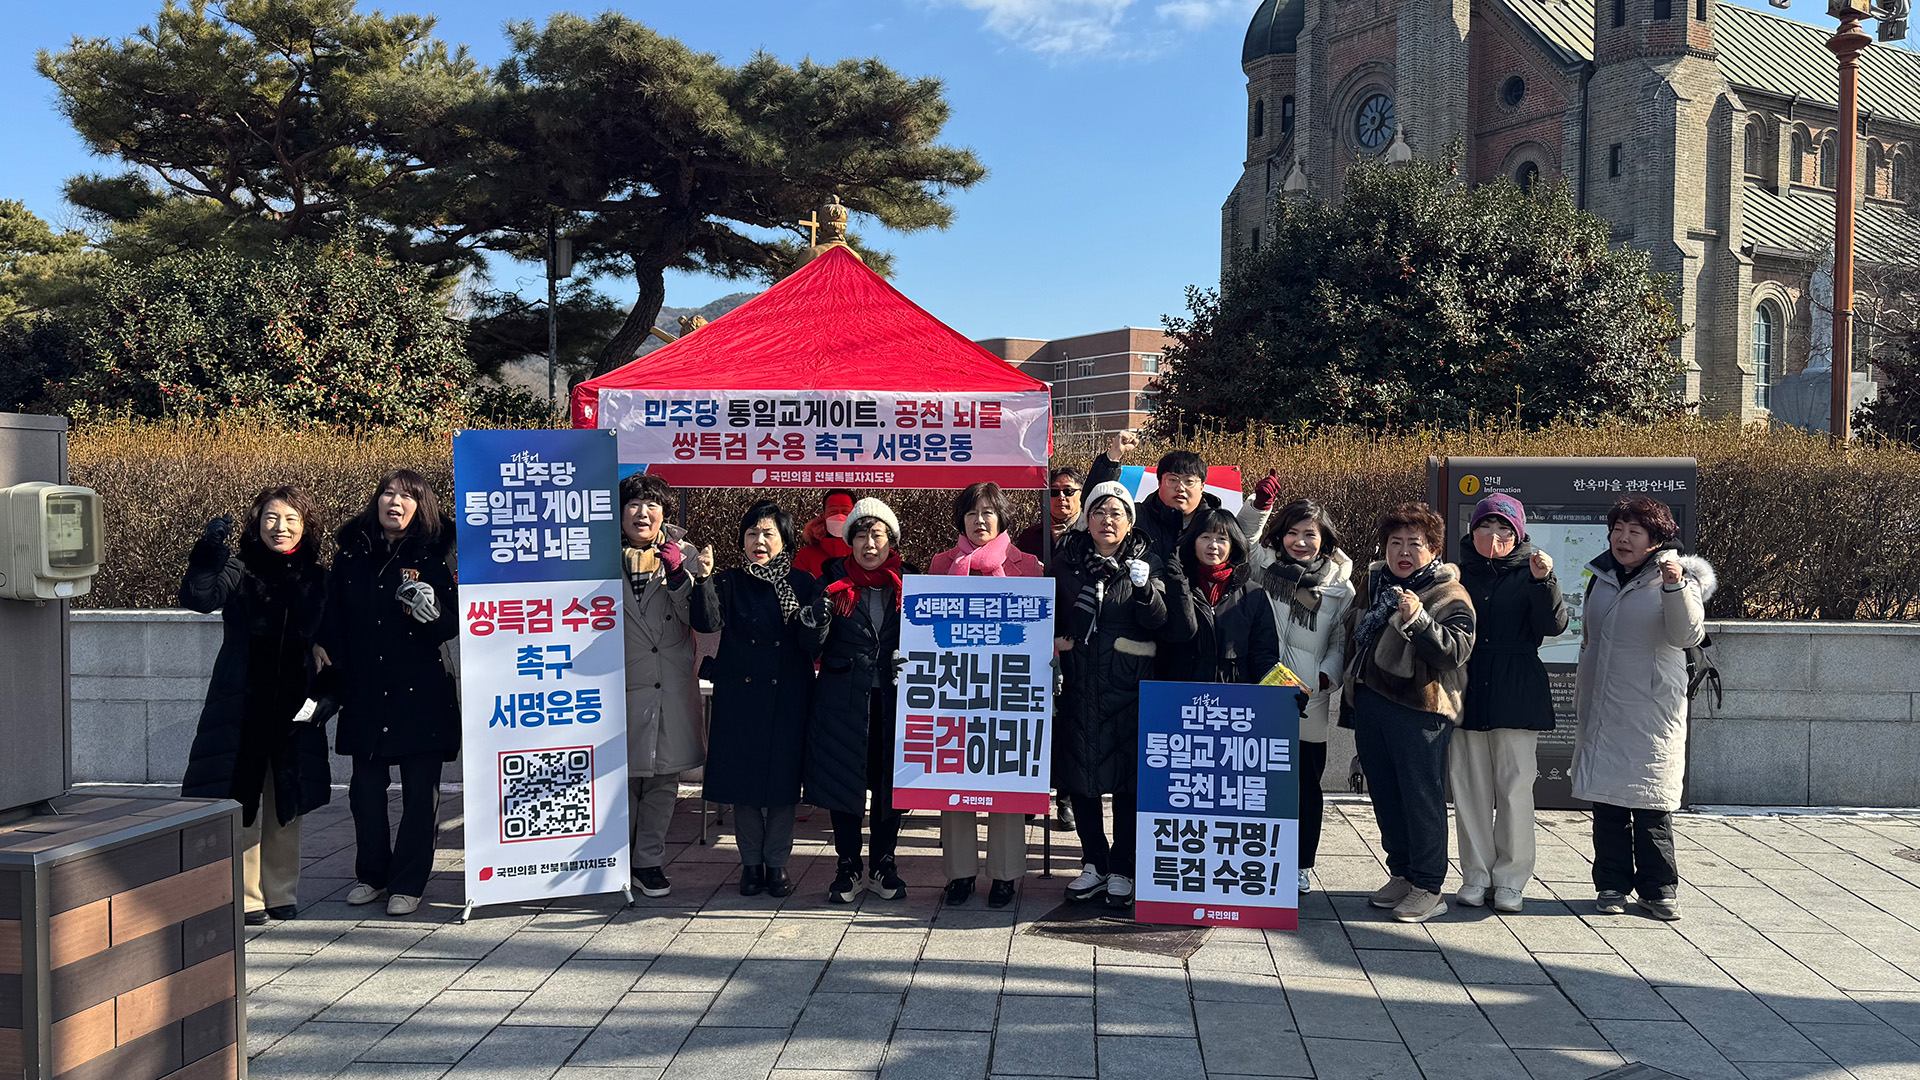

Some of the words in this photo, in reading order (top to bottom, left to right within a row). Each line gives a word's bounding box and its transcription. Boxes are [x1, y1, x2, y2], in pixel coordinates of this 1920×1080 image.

[644, 400, 719, 427] 민주당
[727, 399, 886, 429] 통일교게이트.
[895, 401, 944, 429] 공천
[952, 401, 1003, 429] 뇌물
[511, 450, 539, 463] 더불어
[671, 433, 748, 462] 쌍특검
[756, 433, 807, 461] 수용
[815, 432, 864, 462] 촉구
[872, 432, 974, 462] 서명운동
[500, 462, 576, 487] 민주당
[769, 470, 812, 484] 국민의힘
[814, 470, 895, 484] 전북특별자치도당
[1484, 476, 1501, 486] 안내
[1573, 478, 1622, 493] 한옥마을
[1625, 479, 1687, 493] 관광안내도
[464, 491, 538, 526] 통일교
[542, 490, 613, 524] 게이트
[490, 527, 539, 563] 공천
[544, 527, 591, 561] 뇌물
[467, 598, 553, 636] 쌍특검
[562, 596, 617, 632] 수용
[915, 597, 964, 619] 선택적
[968, 598, 1001, 619] 특검
[1006, 597, 1042, 619] 남발
[951, 623, 1002, 644] 민주당
[516, 644, 573, 680] 촉구
[906, 651, 1045, 713] 공천뇌물도
[489, 688, 602, 728] 서명운동
[1192, 693, 1219, 707] 더불어
[1181, 705, 1255, 732] 민주당
[903, 714, 1044, 777] 특검하라!
[1145, 733, 1215, 769] 통일교
[1219, 736, 1291, 772] 게이트
[962, 795, 993, 806] 국민의힘
[1167, 773, 1214, 809] 공천
[1219, 775, 1267, 811] 뇌물
[1153, 818, 1207, 854] 진상
[1213, 821, 1280, 857] 규명!
[497, 864, 537, 878] 국민의힘
[540, 857, 617, 875] 전북특별자치도당
[1152, 856, 1206, 892] 특검
[1212, 860, 1280, 896] 수용!
[1207, 910, 1239, 921] 국민의힘
